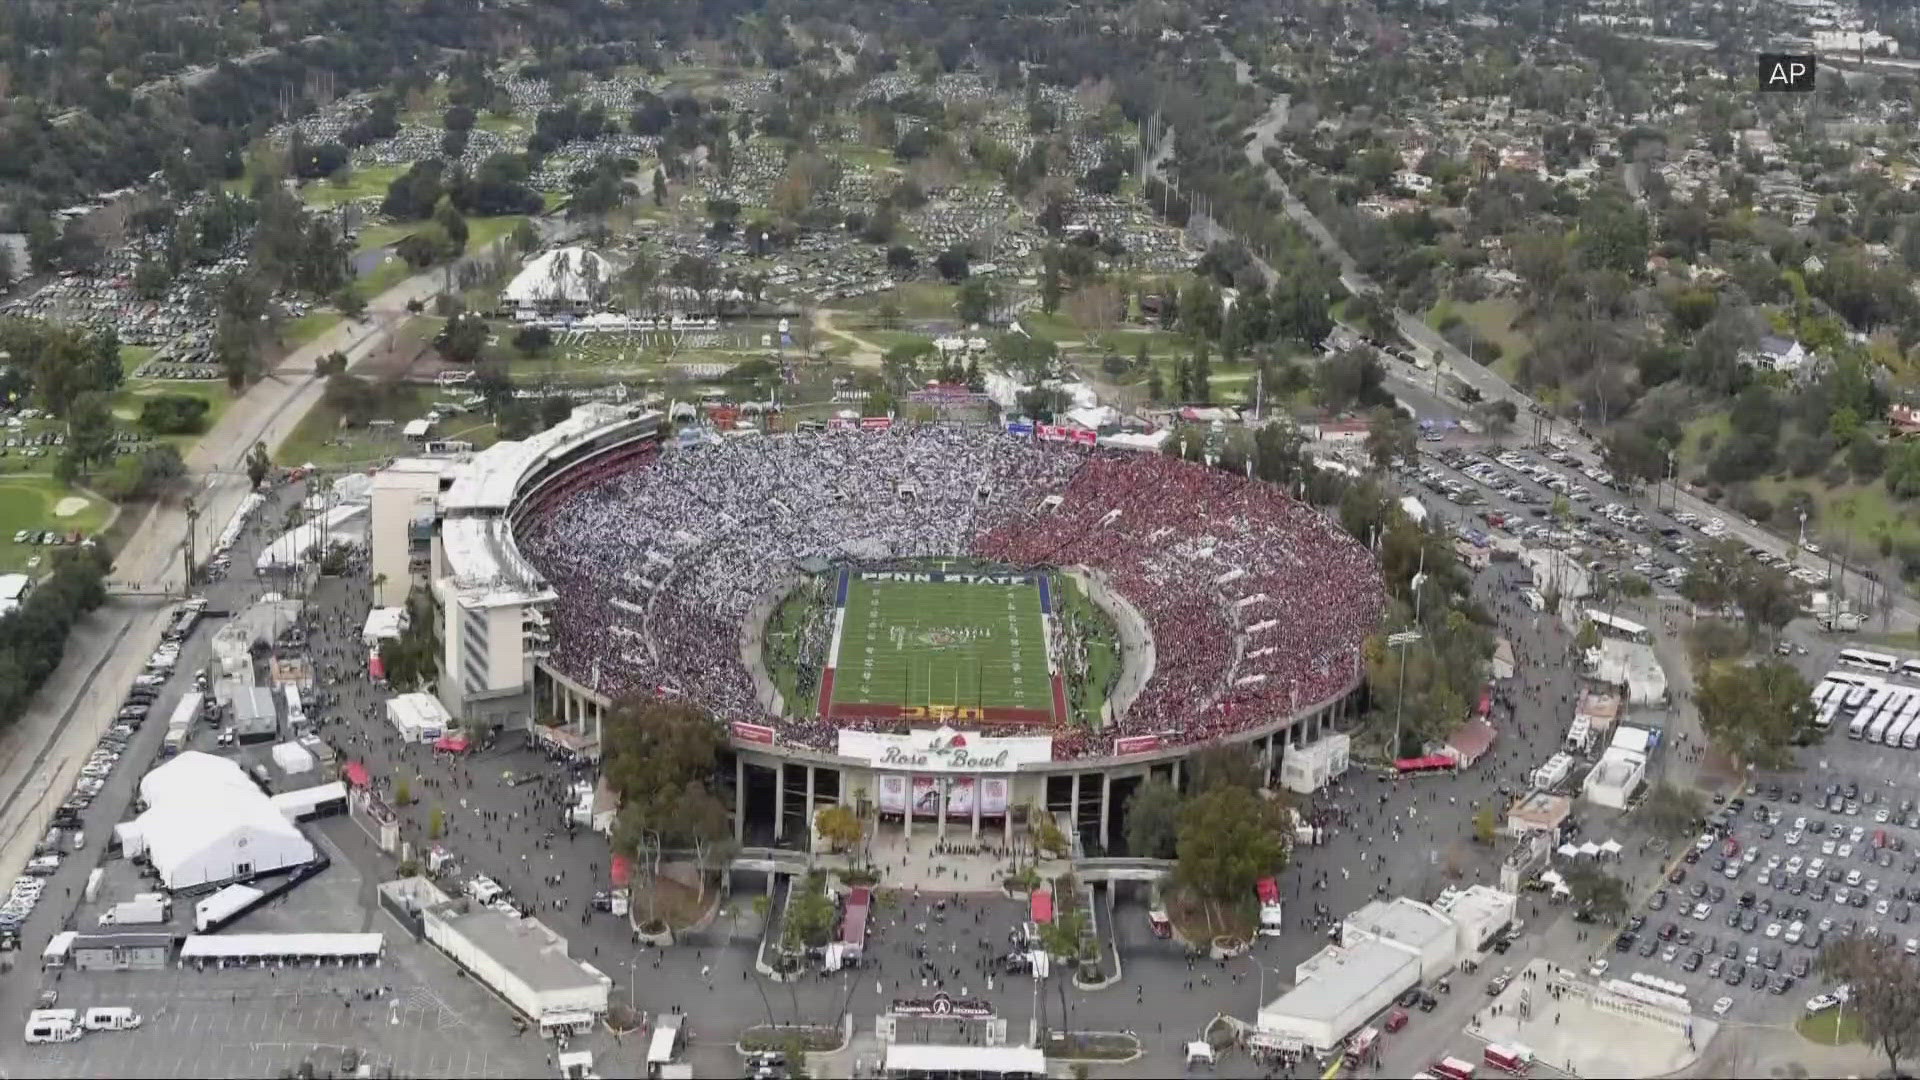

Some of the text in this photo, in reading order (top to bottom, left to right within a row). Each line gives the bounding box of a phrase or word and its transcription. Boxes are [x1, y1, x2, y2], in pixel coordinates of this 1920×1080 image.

[943, 574, 1025, 586] STATE
[880, 746, 1008, 768] Rose Bowl
